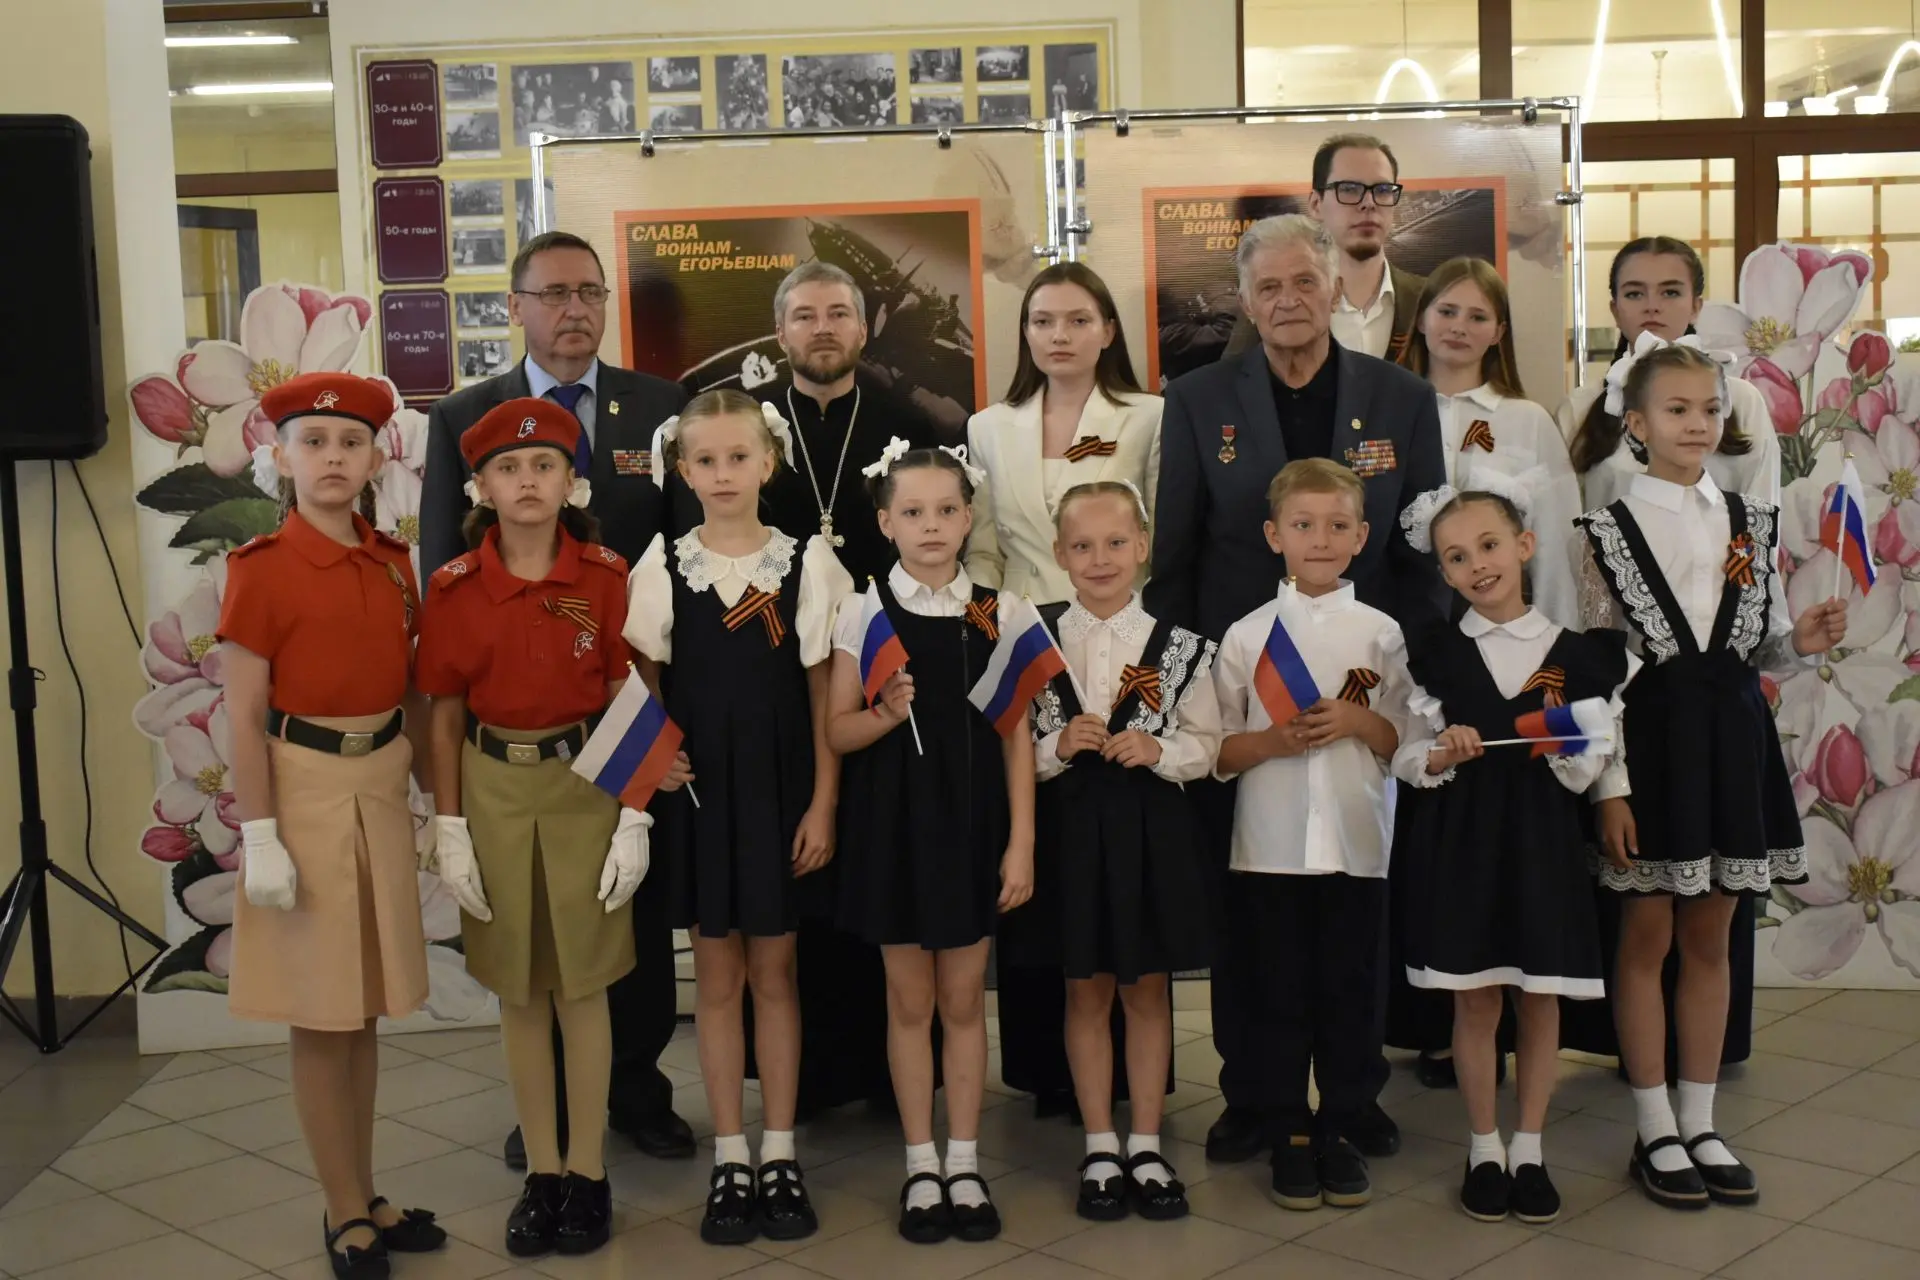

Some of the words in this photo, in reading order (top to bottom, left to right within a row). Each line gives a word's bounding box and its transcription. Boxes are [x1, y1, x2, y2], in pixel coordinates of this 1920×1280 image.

[374, 104, 398, 113] 30-е
[410, 102, 433, 112] 40-е
[392, 117, 417, 126] годы
[1159, 202, 1225, 220] СЛАВА
[386, 226, 408, 235] 50-е
[412, 227, 436, 235] годы
[631, 223, 698, 241] СЛАВА
[656, 241, 731, 256] ВОИНАМ
[679, 255, 795, 272] ЕГОРЬЕВЦАМ
[387, 331, 411, 341] 60-е
[422, 330, 445, 340] 70-е
[404, 346, 429, 354] годы
